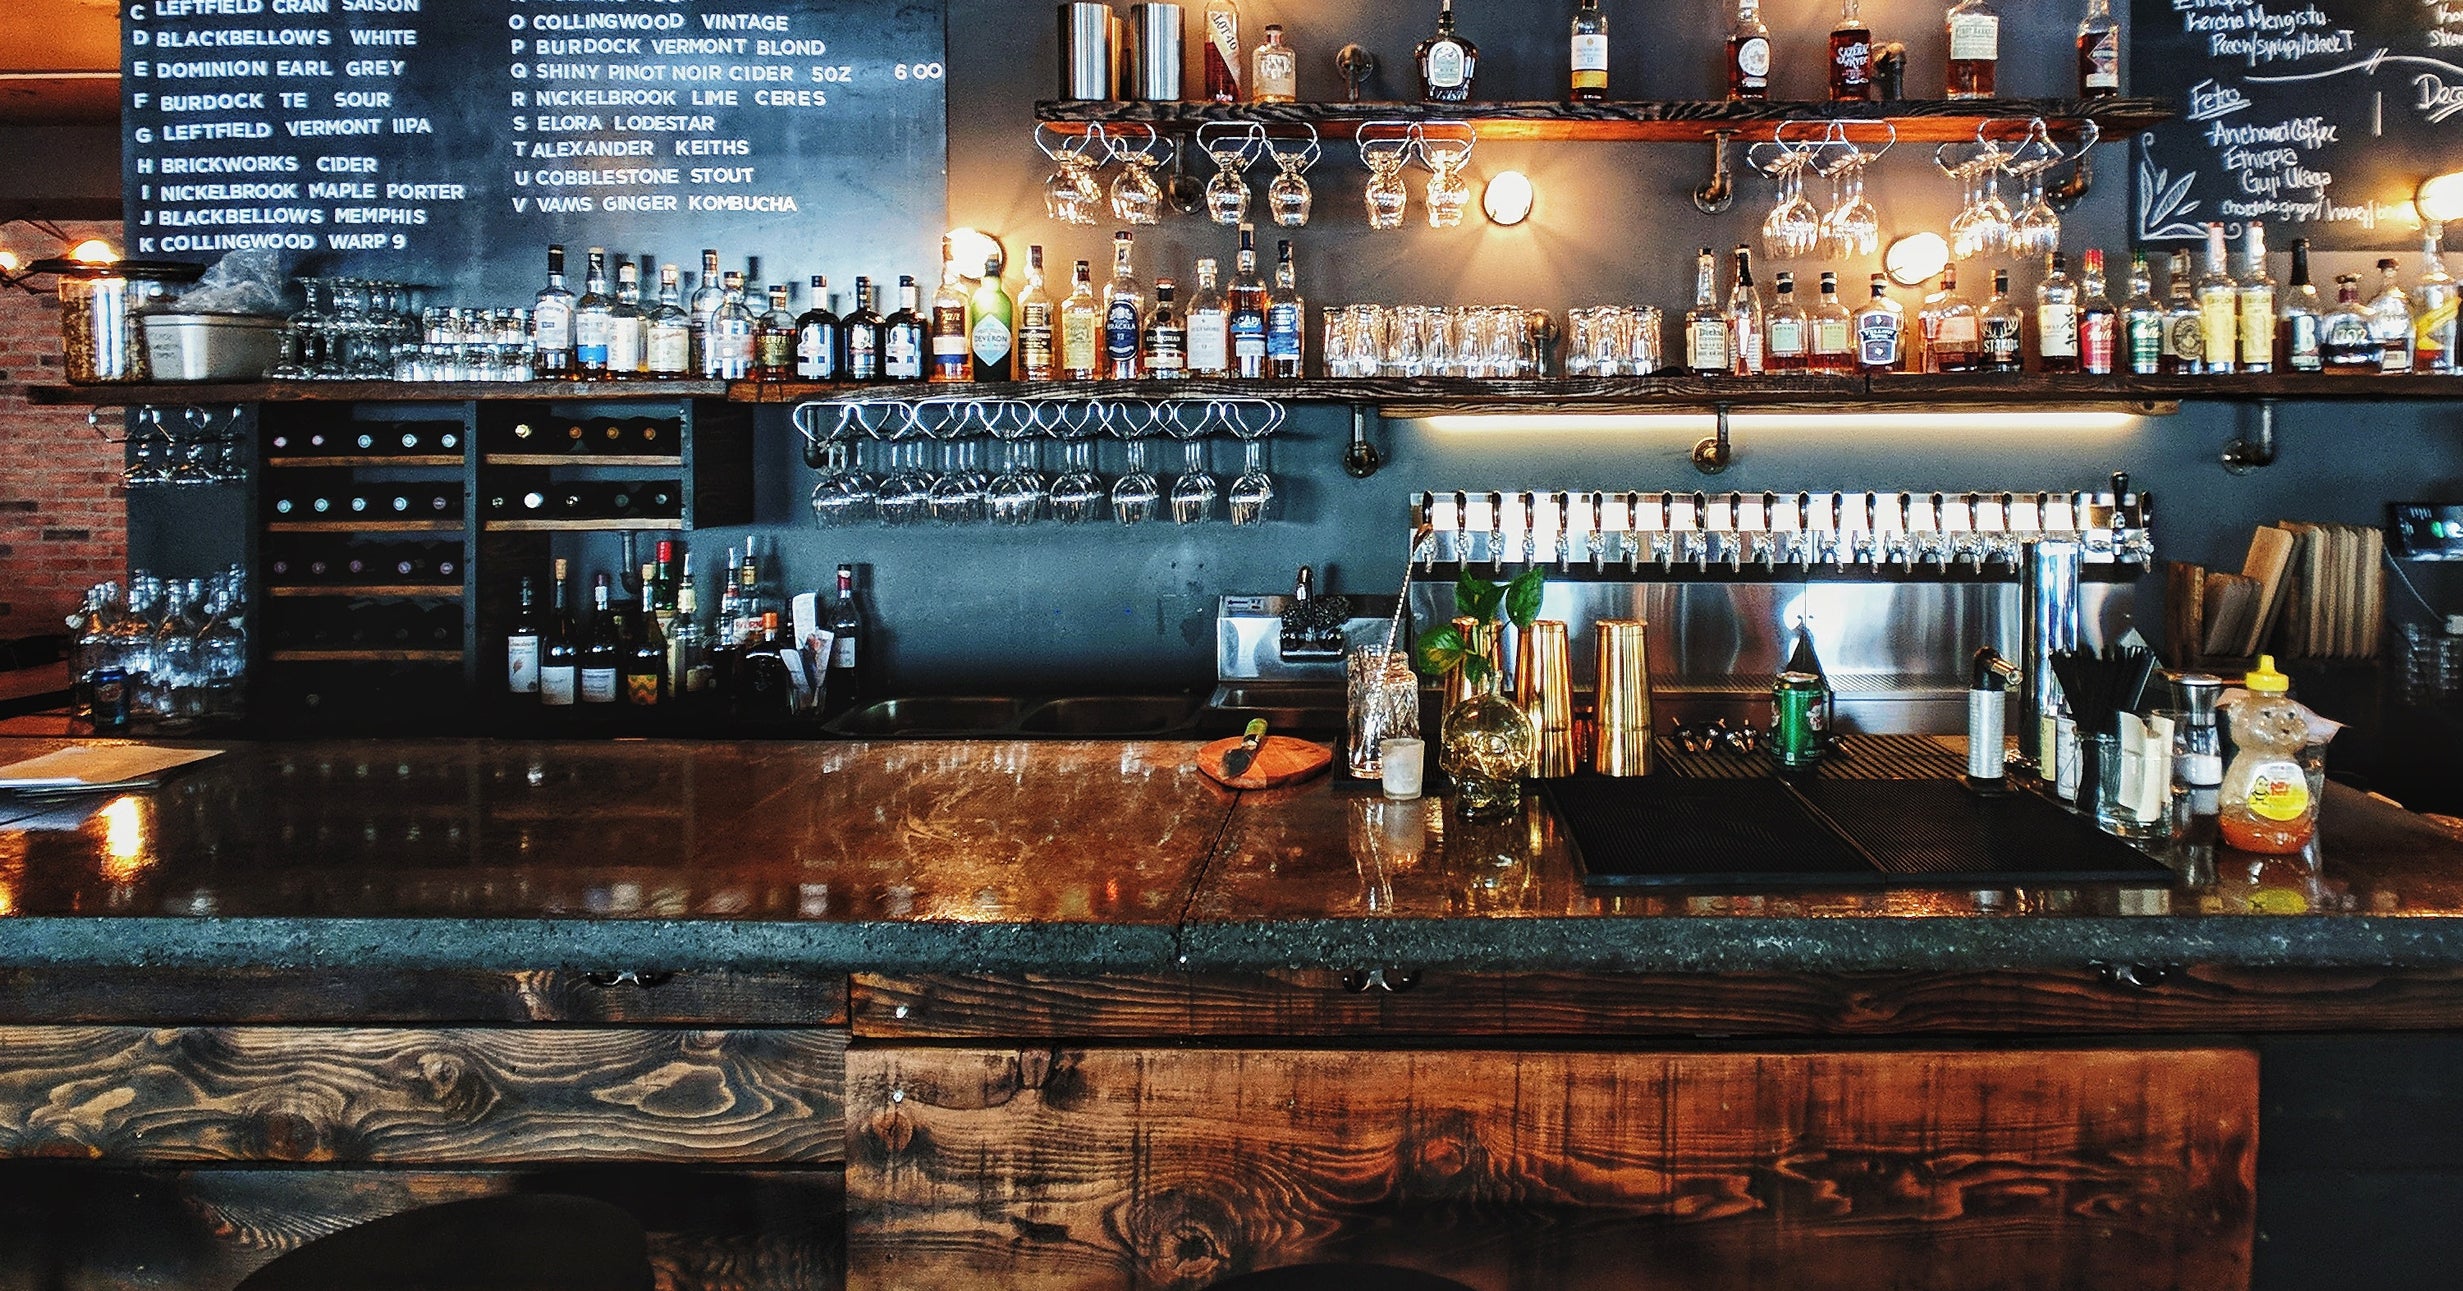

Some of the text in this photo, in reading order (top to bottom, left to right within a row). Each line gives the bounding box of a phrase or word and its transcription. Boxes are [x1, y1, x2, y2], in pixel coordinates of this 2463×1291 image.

[130, 0, 419, 20] C LEFTFIELD CRAN SAISON
[509, 13, 788, 31] O COLLINGWOOD VINTAGE
[133, 30, 416, 47] D BLACKBELLOWS WHITE
[512, 38, 826, 56] P BURDOCK VERMONT BLOND
[134, 60, 404, 78] E DOMINION EARL GREY
[511, 63, 528, 78] Q
[537, 64, 601, 79] SHINY
[608, 65, 666, 81] PINOT
[673, 65, 724, 81] NOIR
[726, 66, 793, 81] CIDER
[894, 63, 907, 80] 6
[134, 92, 391, 111] F BURDOCK TE SOUR
[512, 89, 826, 106] R NICKELBROOK LIME CERES
[136, 118, 431, 143] G LEFTFIELD VERMONT IIPA
[514, 116, 715, 131] S ELORA LODESTAR
[513, 140, 749, 158] T ALEXANDER KEITHS
[138, 156, 377, 173] H BRICKWORKS CIDER
[515, 168, 754, 185] U COBBLESTONE STOUT
[161, 184, 298, 201] NICKELBROOK
[309, 183, 376, 198] MAPLE
[387, 184, 465, 199] PORTER
[512, 198, 527, 212] V
[603, 196, 677, 211] GINGER
[689, 196, 798, 211] KOMBUCHA
[140, 208, 426, 226] J BLACKBELLOWS MEMPHIS
[140, 234, 406, 252] K COLLINGWOOD WARP 9
